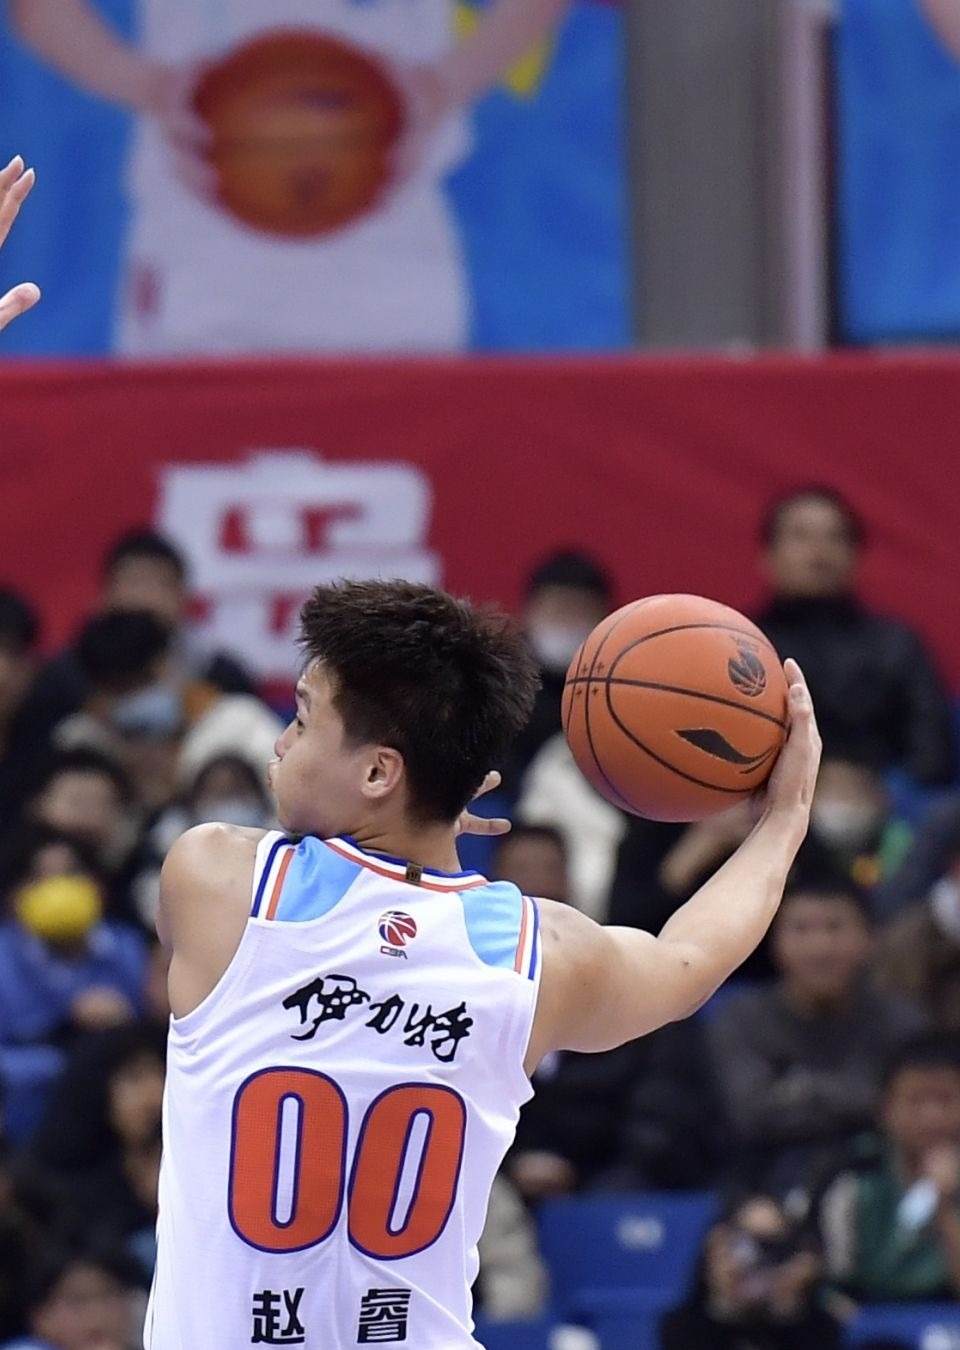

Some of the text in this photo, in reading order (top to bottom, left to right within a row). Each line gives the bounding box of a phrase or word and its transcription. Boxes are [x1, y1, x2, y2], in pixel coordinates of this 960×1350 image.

[282, 973, 474, 1063] 伊力特
[227, 1065, 468, 1262] 00
[251, 1287, 412, 1345] 赵睿
